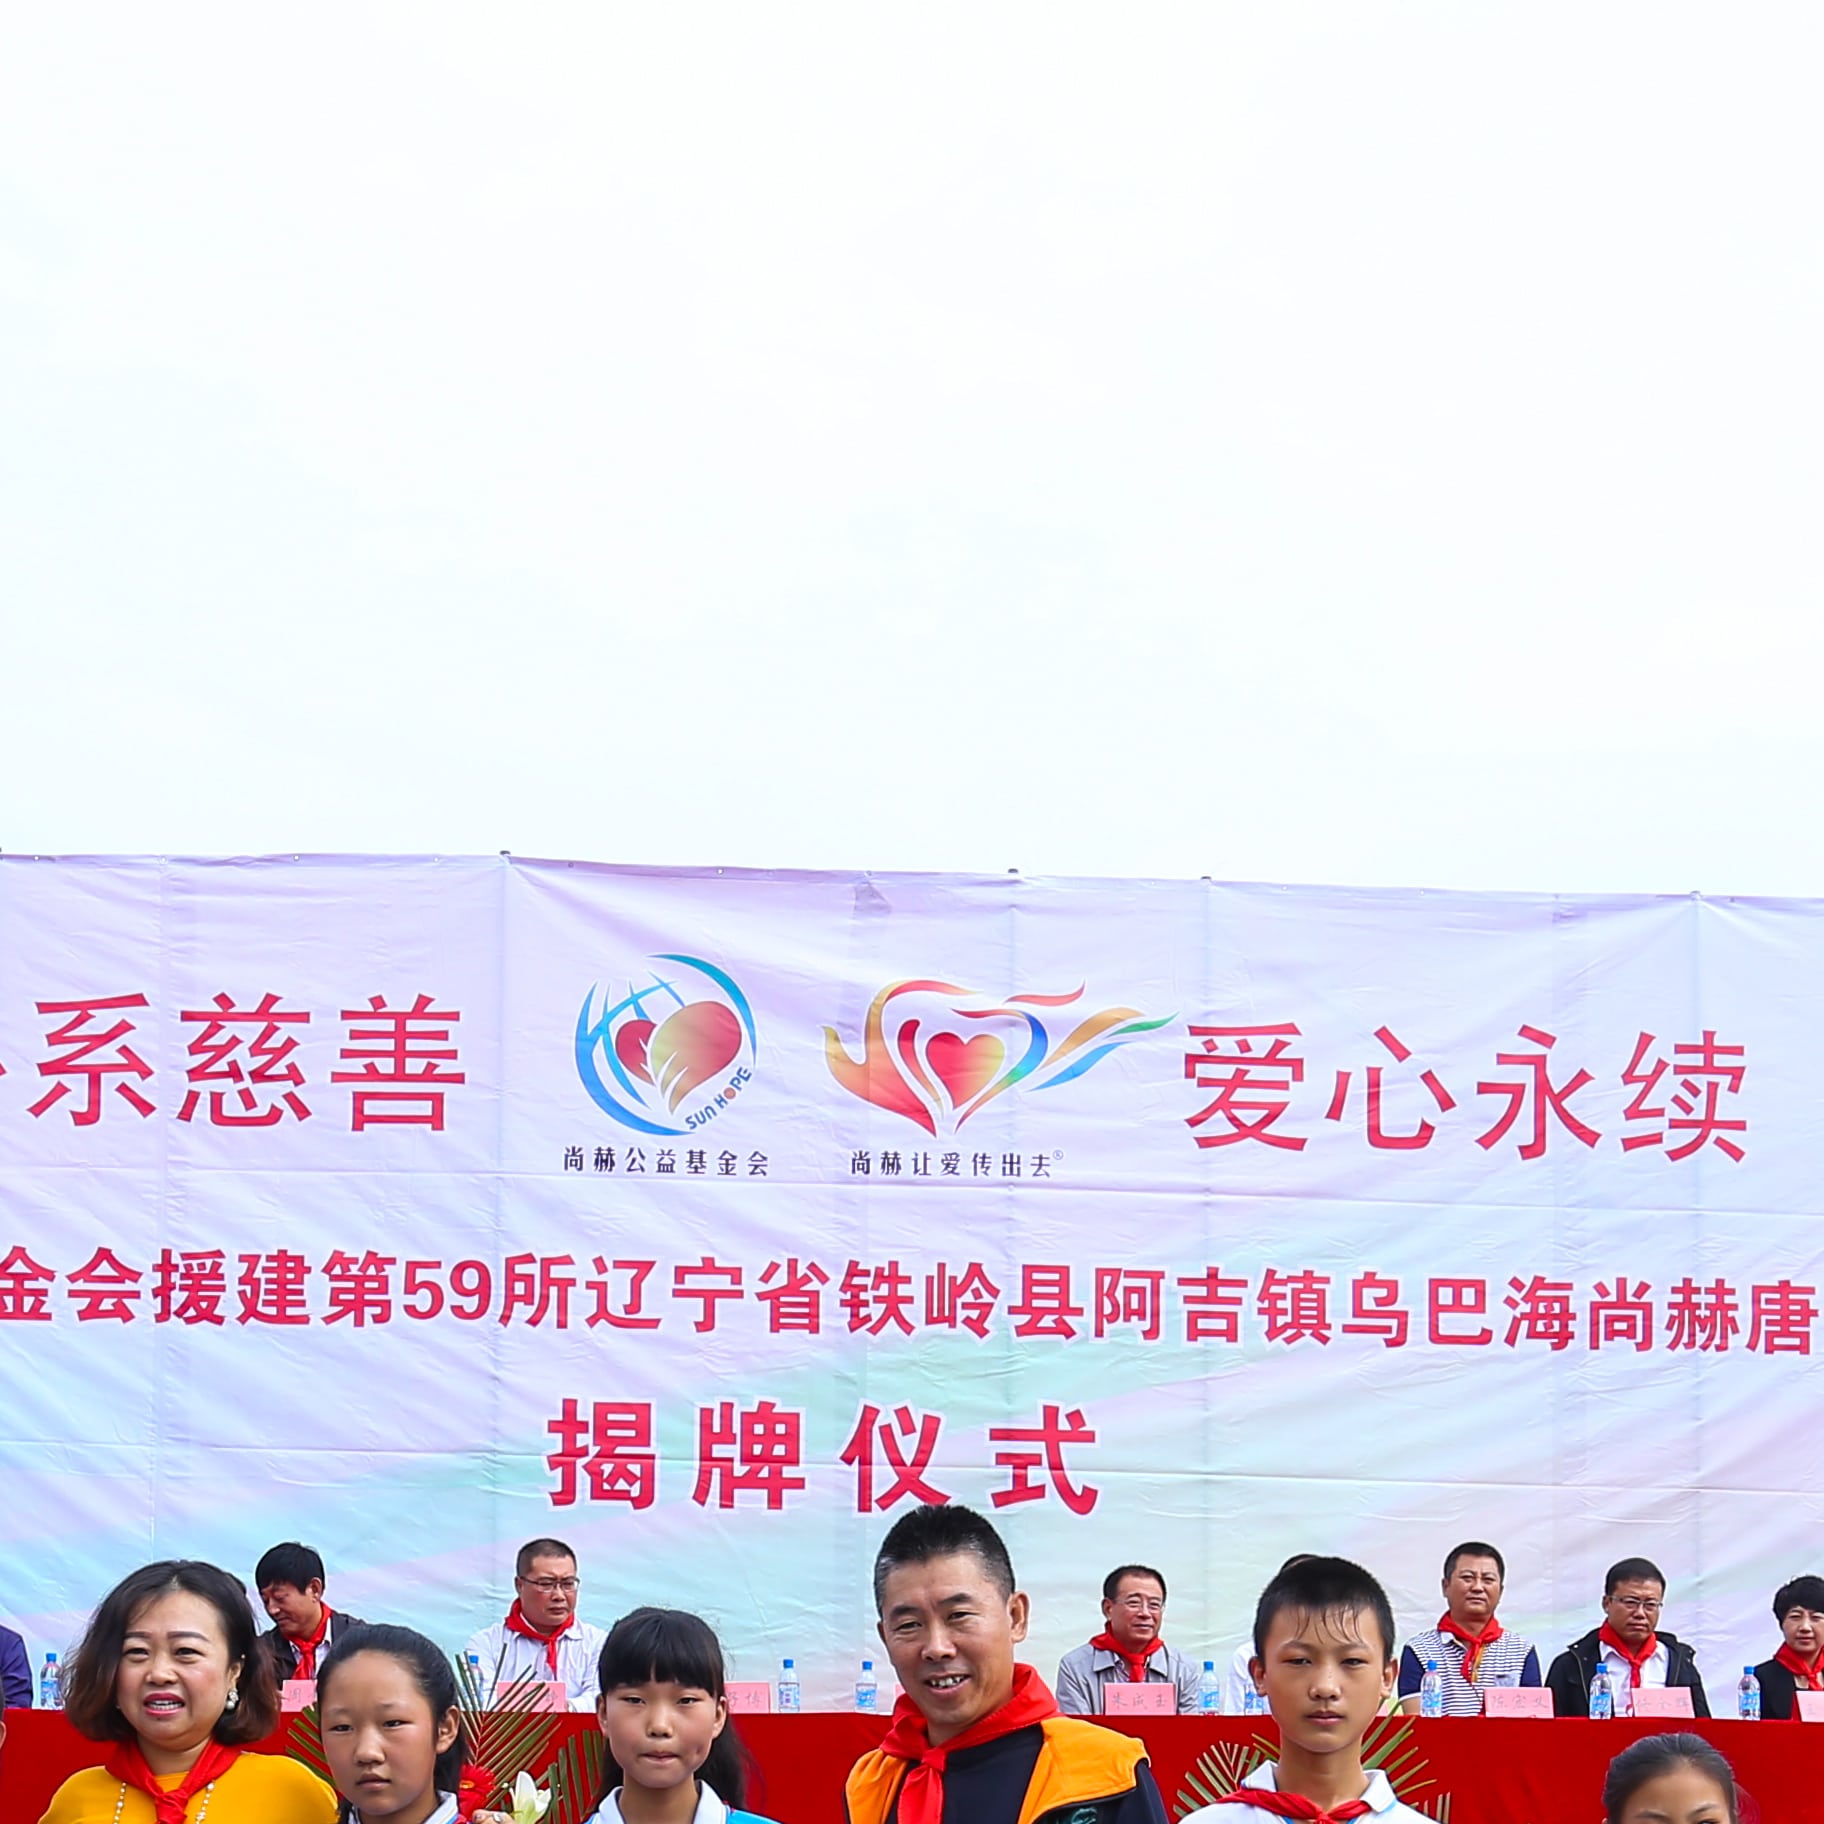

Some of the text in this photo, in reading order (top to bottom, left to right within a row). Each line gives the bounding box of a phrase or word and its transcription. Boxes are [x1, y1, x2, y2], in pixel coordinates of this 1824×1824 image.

[685, 1067, 752, 1130] SUN HOPE
[1182, 1021, 1750, 1165] 爱心永续
[564, 1147, 769, 1177] 尚赫公益基金会
[851, 1151, 1051, 1177] 尚赫让爱传出去
[547, 1396, 1100, 1516] 揭牌仪式
